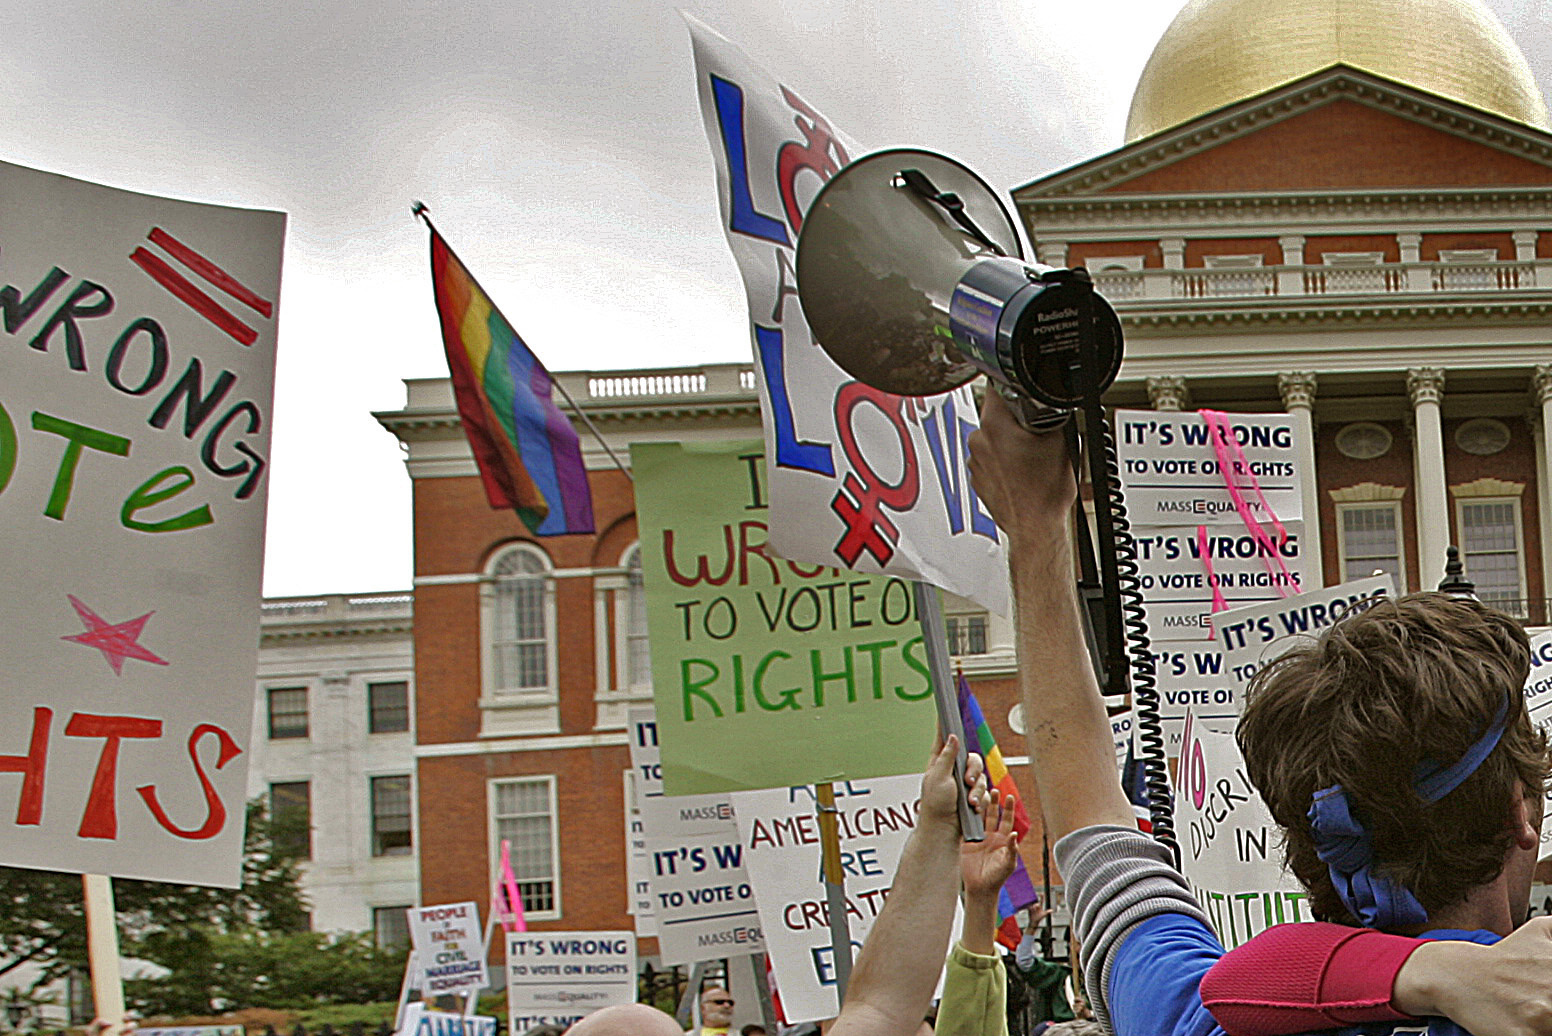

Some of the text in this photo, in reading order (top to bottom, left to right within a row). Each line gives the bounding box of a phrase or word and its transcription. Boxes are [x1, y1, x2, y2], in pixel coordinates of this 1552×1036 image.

[1124, 421, 1291, 448] IT'S WRONG
[1125, 460, 1148, 473] TO
[1152, 460, 1196, 474] VOTE
[1188, 536, 1298, 561] WRONG
[1159, 575, 1202, 588] VOTE
[1208, 573, 1233, 588] ON
[1239, 571, 1301, 588] RIGHTS
[675, 577, 920, 641] TO VOTE O
[1222, 616, 1275, 651] IT'S
[681, 636, 935, 722] RIGHTS
[1166, 690, 1209, 705] VOTE
[1236, 826, 1267, 862] IN
[654, 846, 707, 876] IT'S
[659, 891, 684, 908] TO
[688, 885, 734, 906] VOTE
[511, 940, 627, 955] IT'S WRONG
[512, 964, 628, 975] TO VOTE ON RIGHTS
